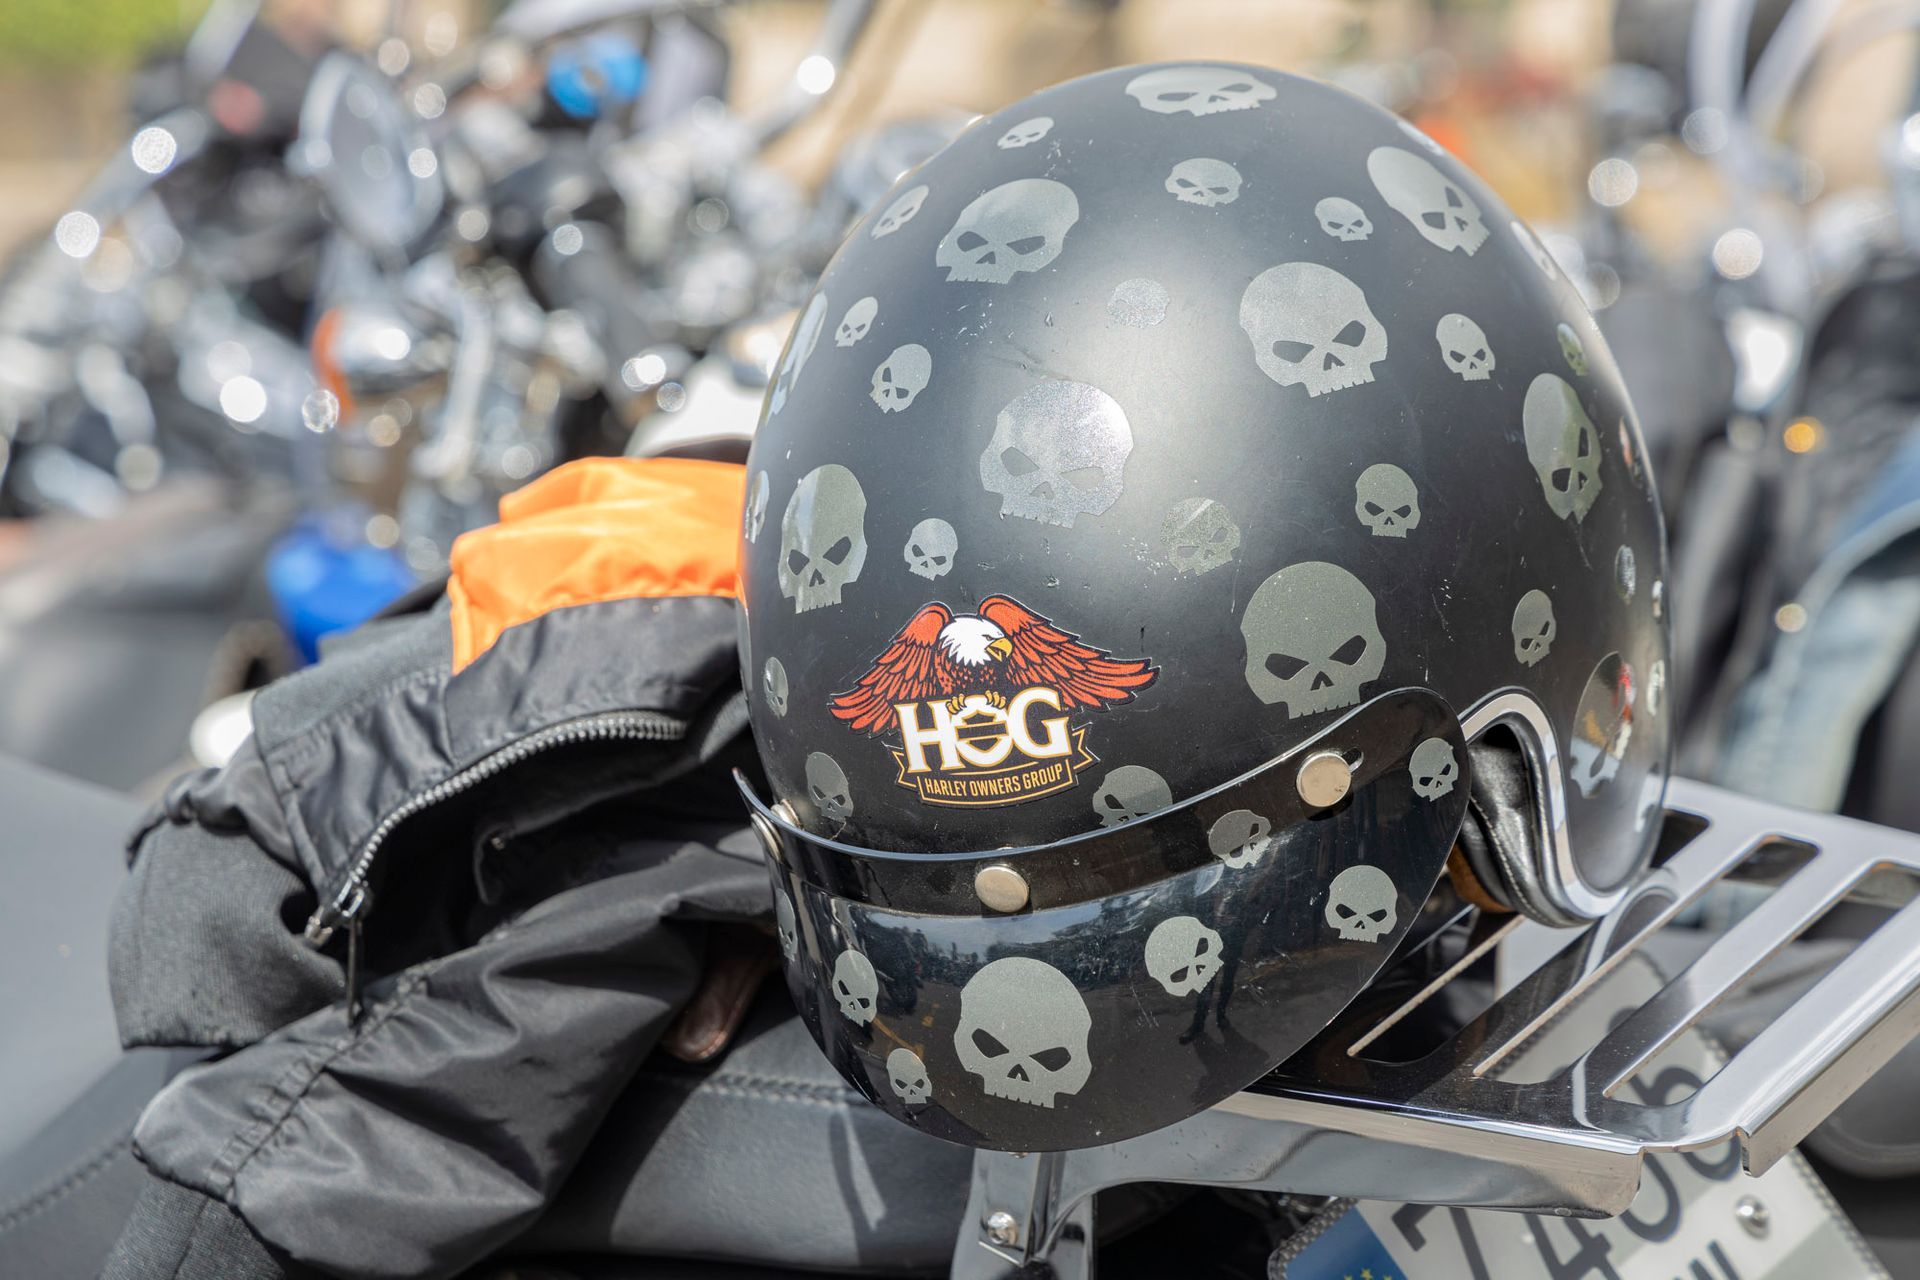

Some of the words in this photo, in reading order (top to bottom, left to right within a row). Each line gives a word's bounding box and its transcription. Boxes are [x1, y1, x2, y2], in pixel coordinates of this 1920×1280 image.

[894, 687, 1072, 773] HOG
[925, 776, 966, 797] HARLEY
[970, 769, 1021, 796] OWNERS
[1022, 763, 1063, 789] GROUP
